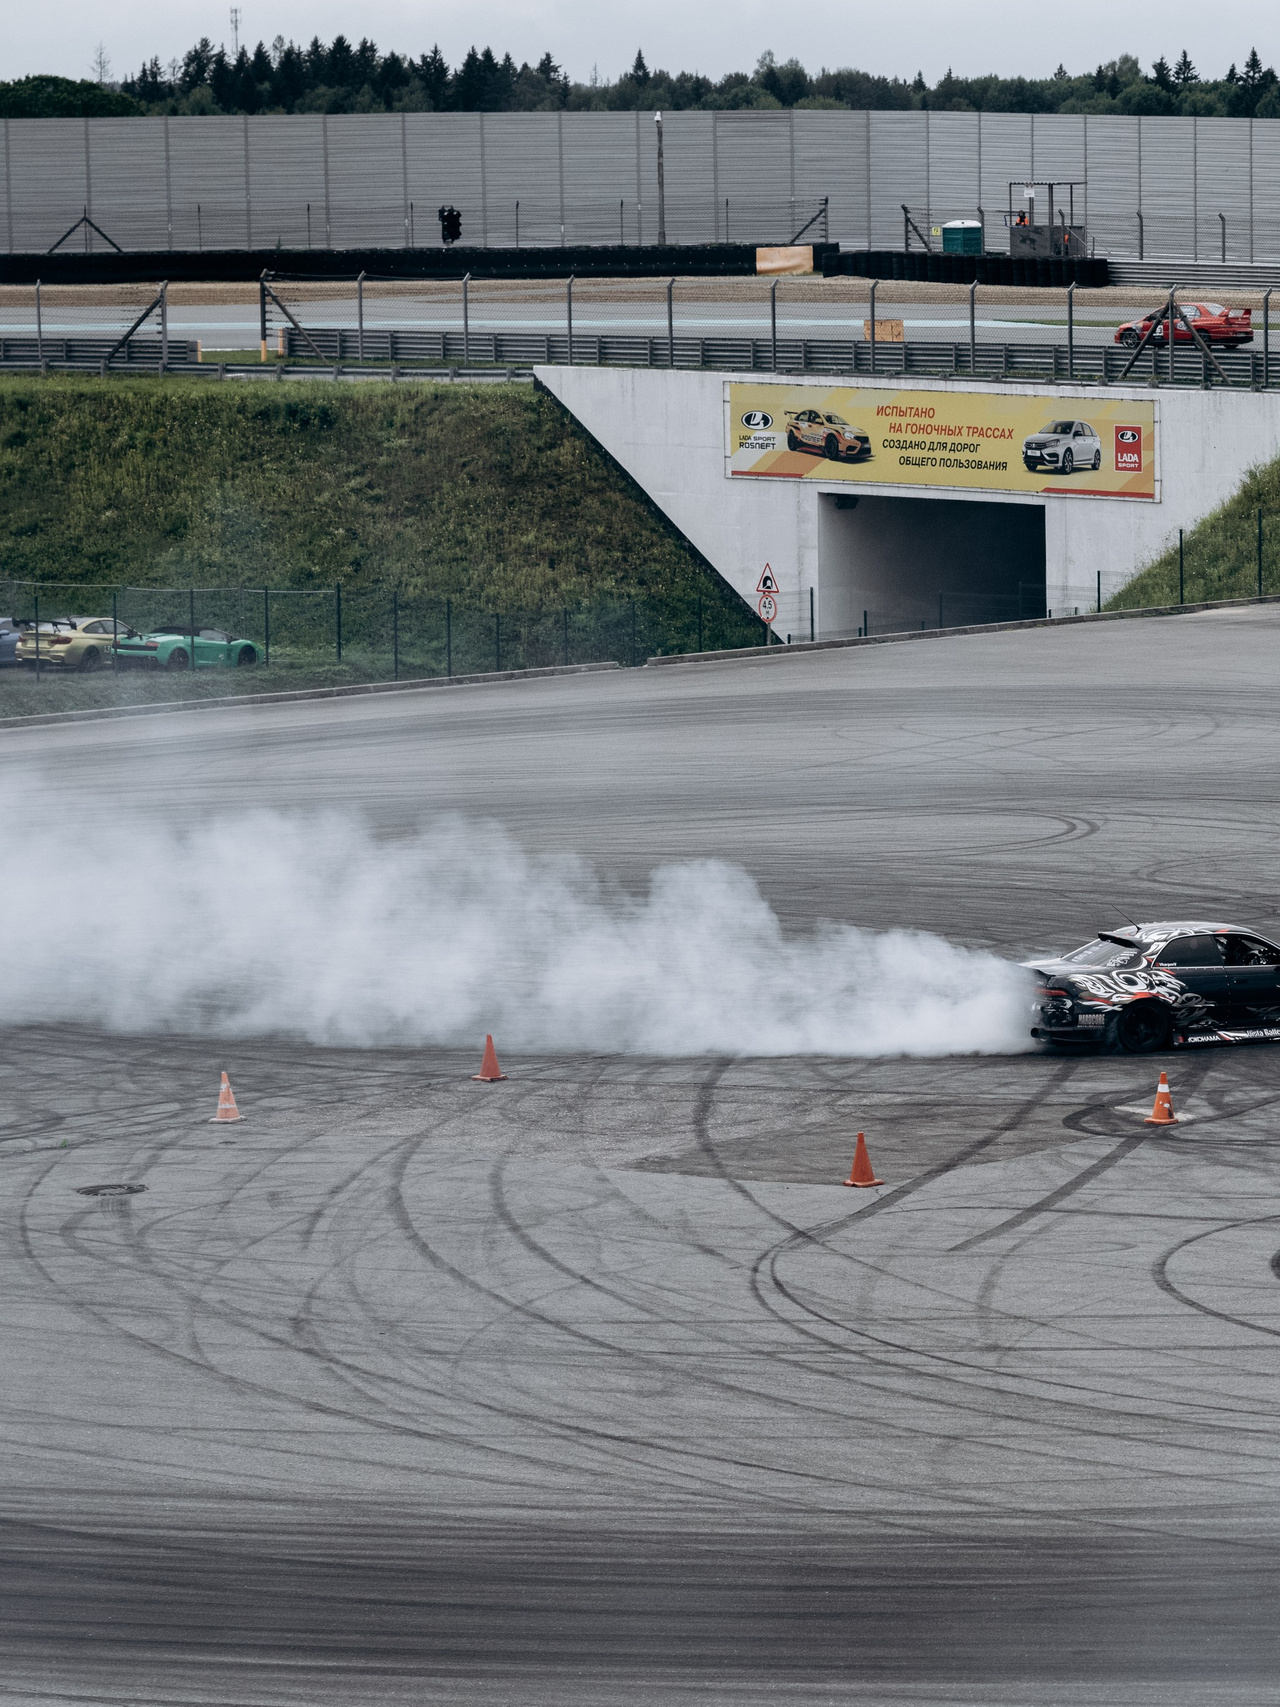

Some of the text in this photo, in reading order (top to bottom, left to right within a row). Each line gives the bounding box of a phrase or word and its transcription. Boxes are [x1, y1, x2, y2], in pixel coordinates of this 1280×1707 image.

[876, 405, 935, 419] ИСПЫТАНО
[889, 422, 1014, 439] НА ГОНОЧНЫХ ТРАССАХ
[882, 439, 981, 454] СОЗДАНО ДЛЯ ДОРОГ
[898, 456, 1008, 471] ОБЩЕГО ПОЛЬЗОВАНИЯ
[1117, 452, 1139, 463] LADA
[1187, 1035, 1221, 1043] YOKOHAMA
